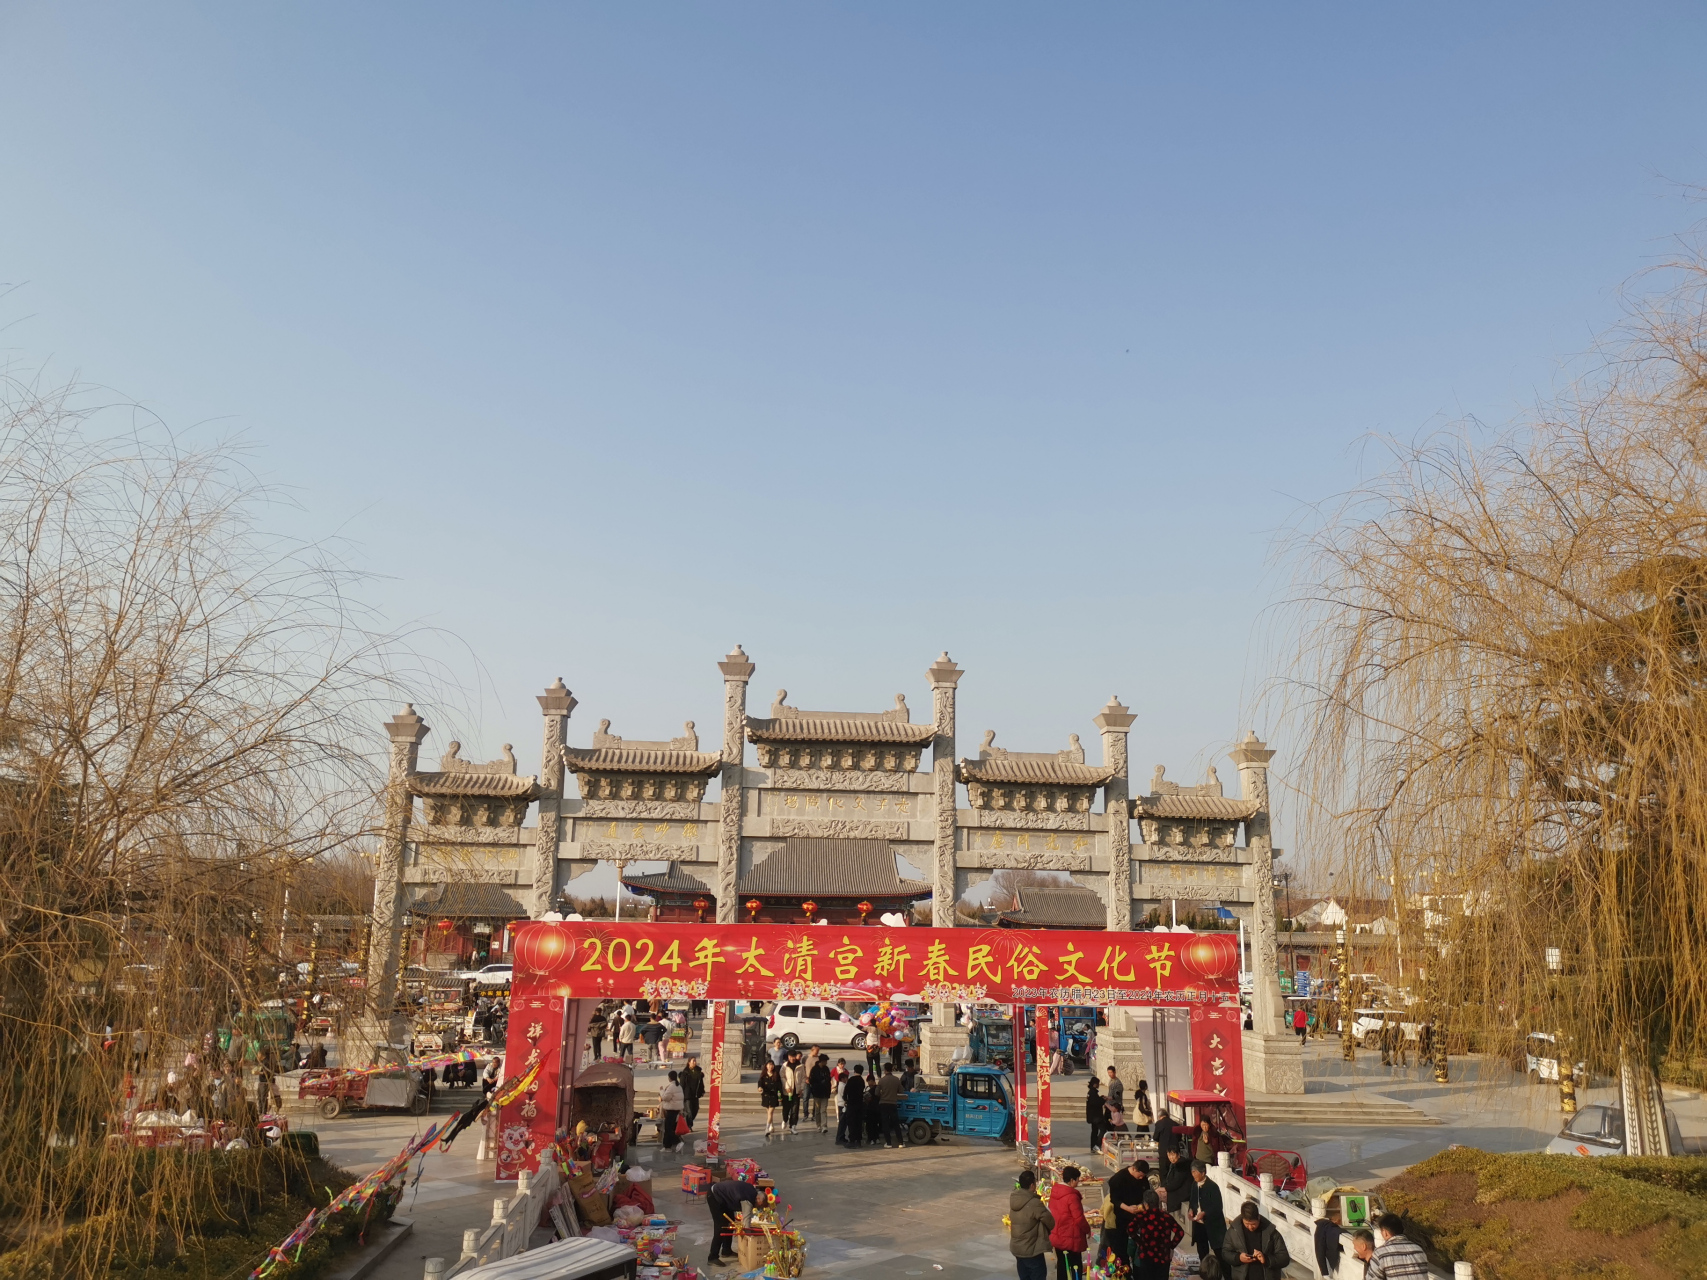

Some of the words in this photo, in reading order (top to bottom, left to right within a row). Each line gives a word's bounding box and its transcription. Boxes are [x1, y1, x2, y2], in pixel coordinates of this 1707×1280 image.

[580, 936, 1176, 989] 2024年太清宫新春民俗文化节
[1012, 987, 1230, 1003] 2023年农历腊月23日至2024年农历正月十五
